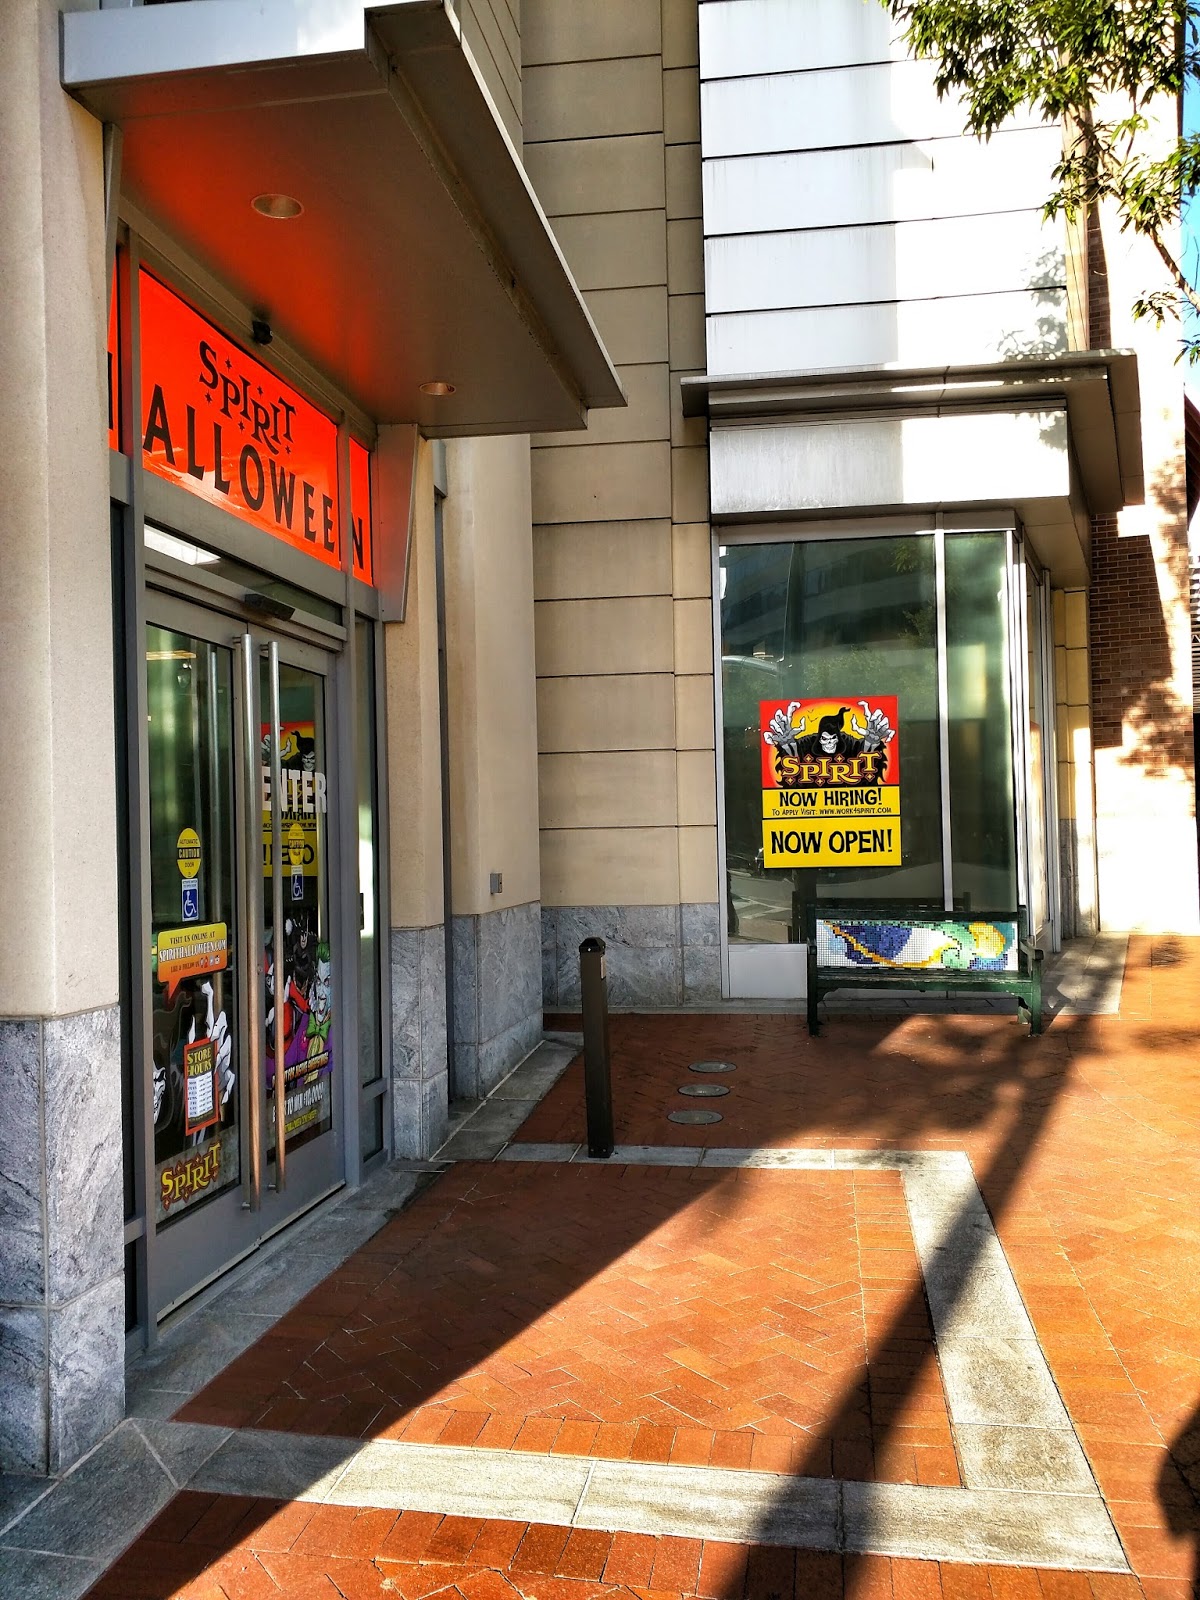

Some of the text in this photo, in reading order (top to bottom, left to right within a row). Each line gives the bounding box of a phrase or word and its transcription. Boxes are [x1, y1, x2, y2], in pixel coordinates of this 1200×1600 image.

[199, 340, 297, 456] SPIRIT
[781, 752, 882, 783] SPIRIT
[779, 788, 883, 807] NOW HIRING!
[771, 829, 893, 854] NOW OPEN!
[178, 848, 200, 859] CAUTION
[169, 937, 183, 945] VISIT
[184, 935, 191, 943] US
[191, 932, 208, 941] ONLINE
[159, 939, 226, 963] SPIRITHALLOWEEN.COM
[187, 1047, 212, 1065] STORE
[187, 1059, 212, 1077] HOURS
[161, 1141, 222, 1202] SPIRIT
